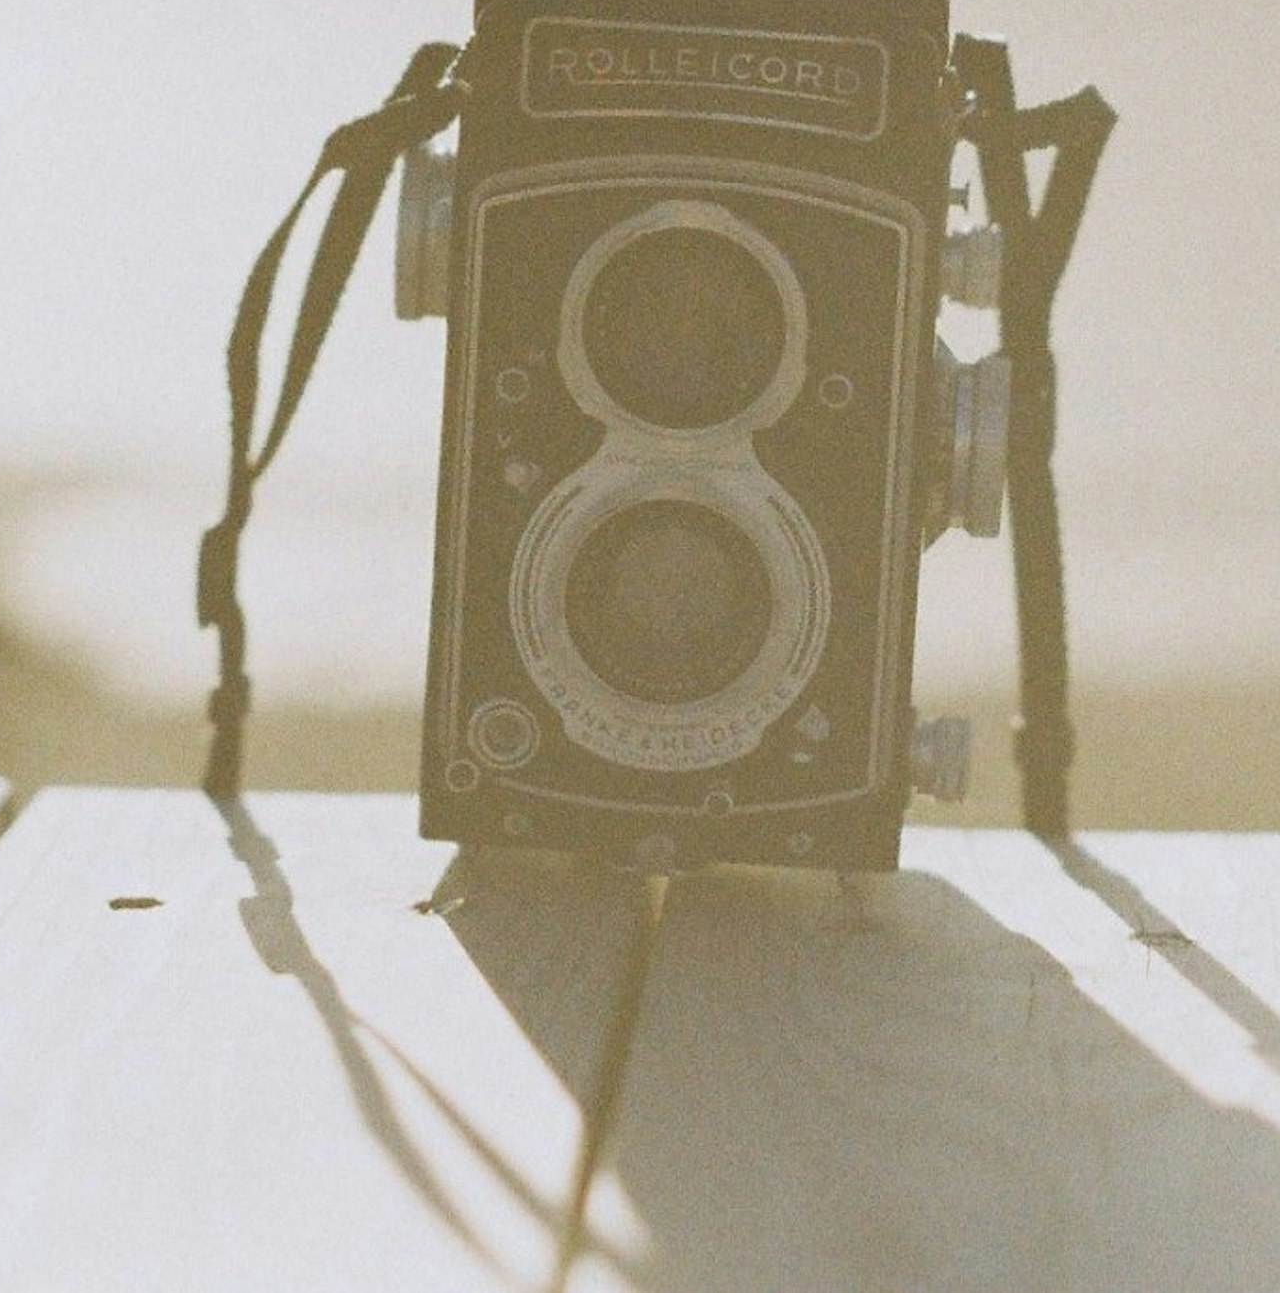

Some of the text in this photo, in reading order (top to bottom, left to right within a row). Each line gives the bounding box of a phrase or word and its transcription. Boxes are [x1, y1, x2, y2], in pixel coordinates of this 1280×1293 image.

[549, 47, 861, 96] ROLLEICORD
[538, 663, 634, 745] FRANKE
[661, 686, 793, 751] HEIDECKE
